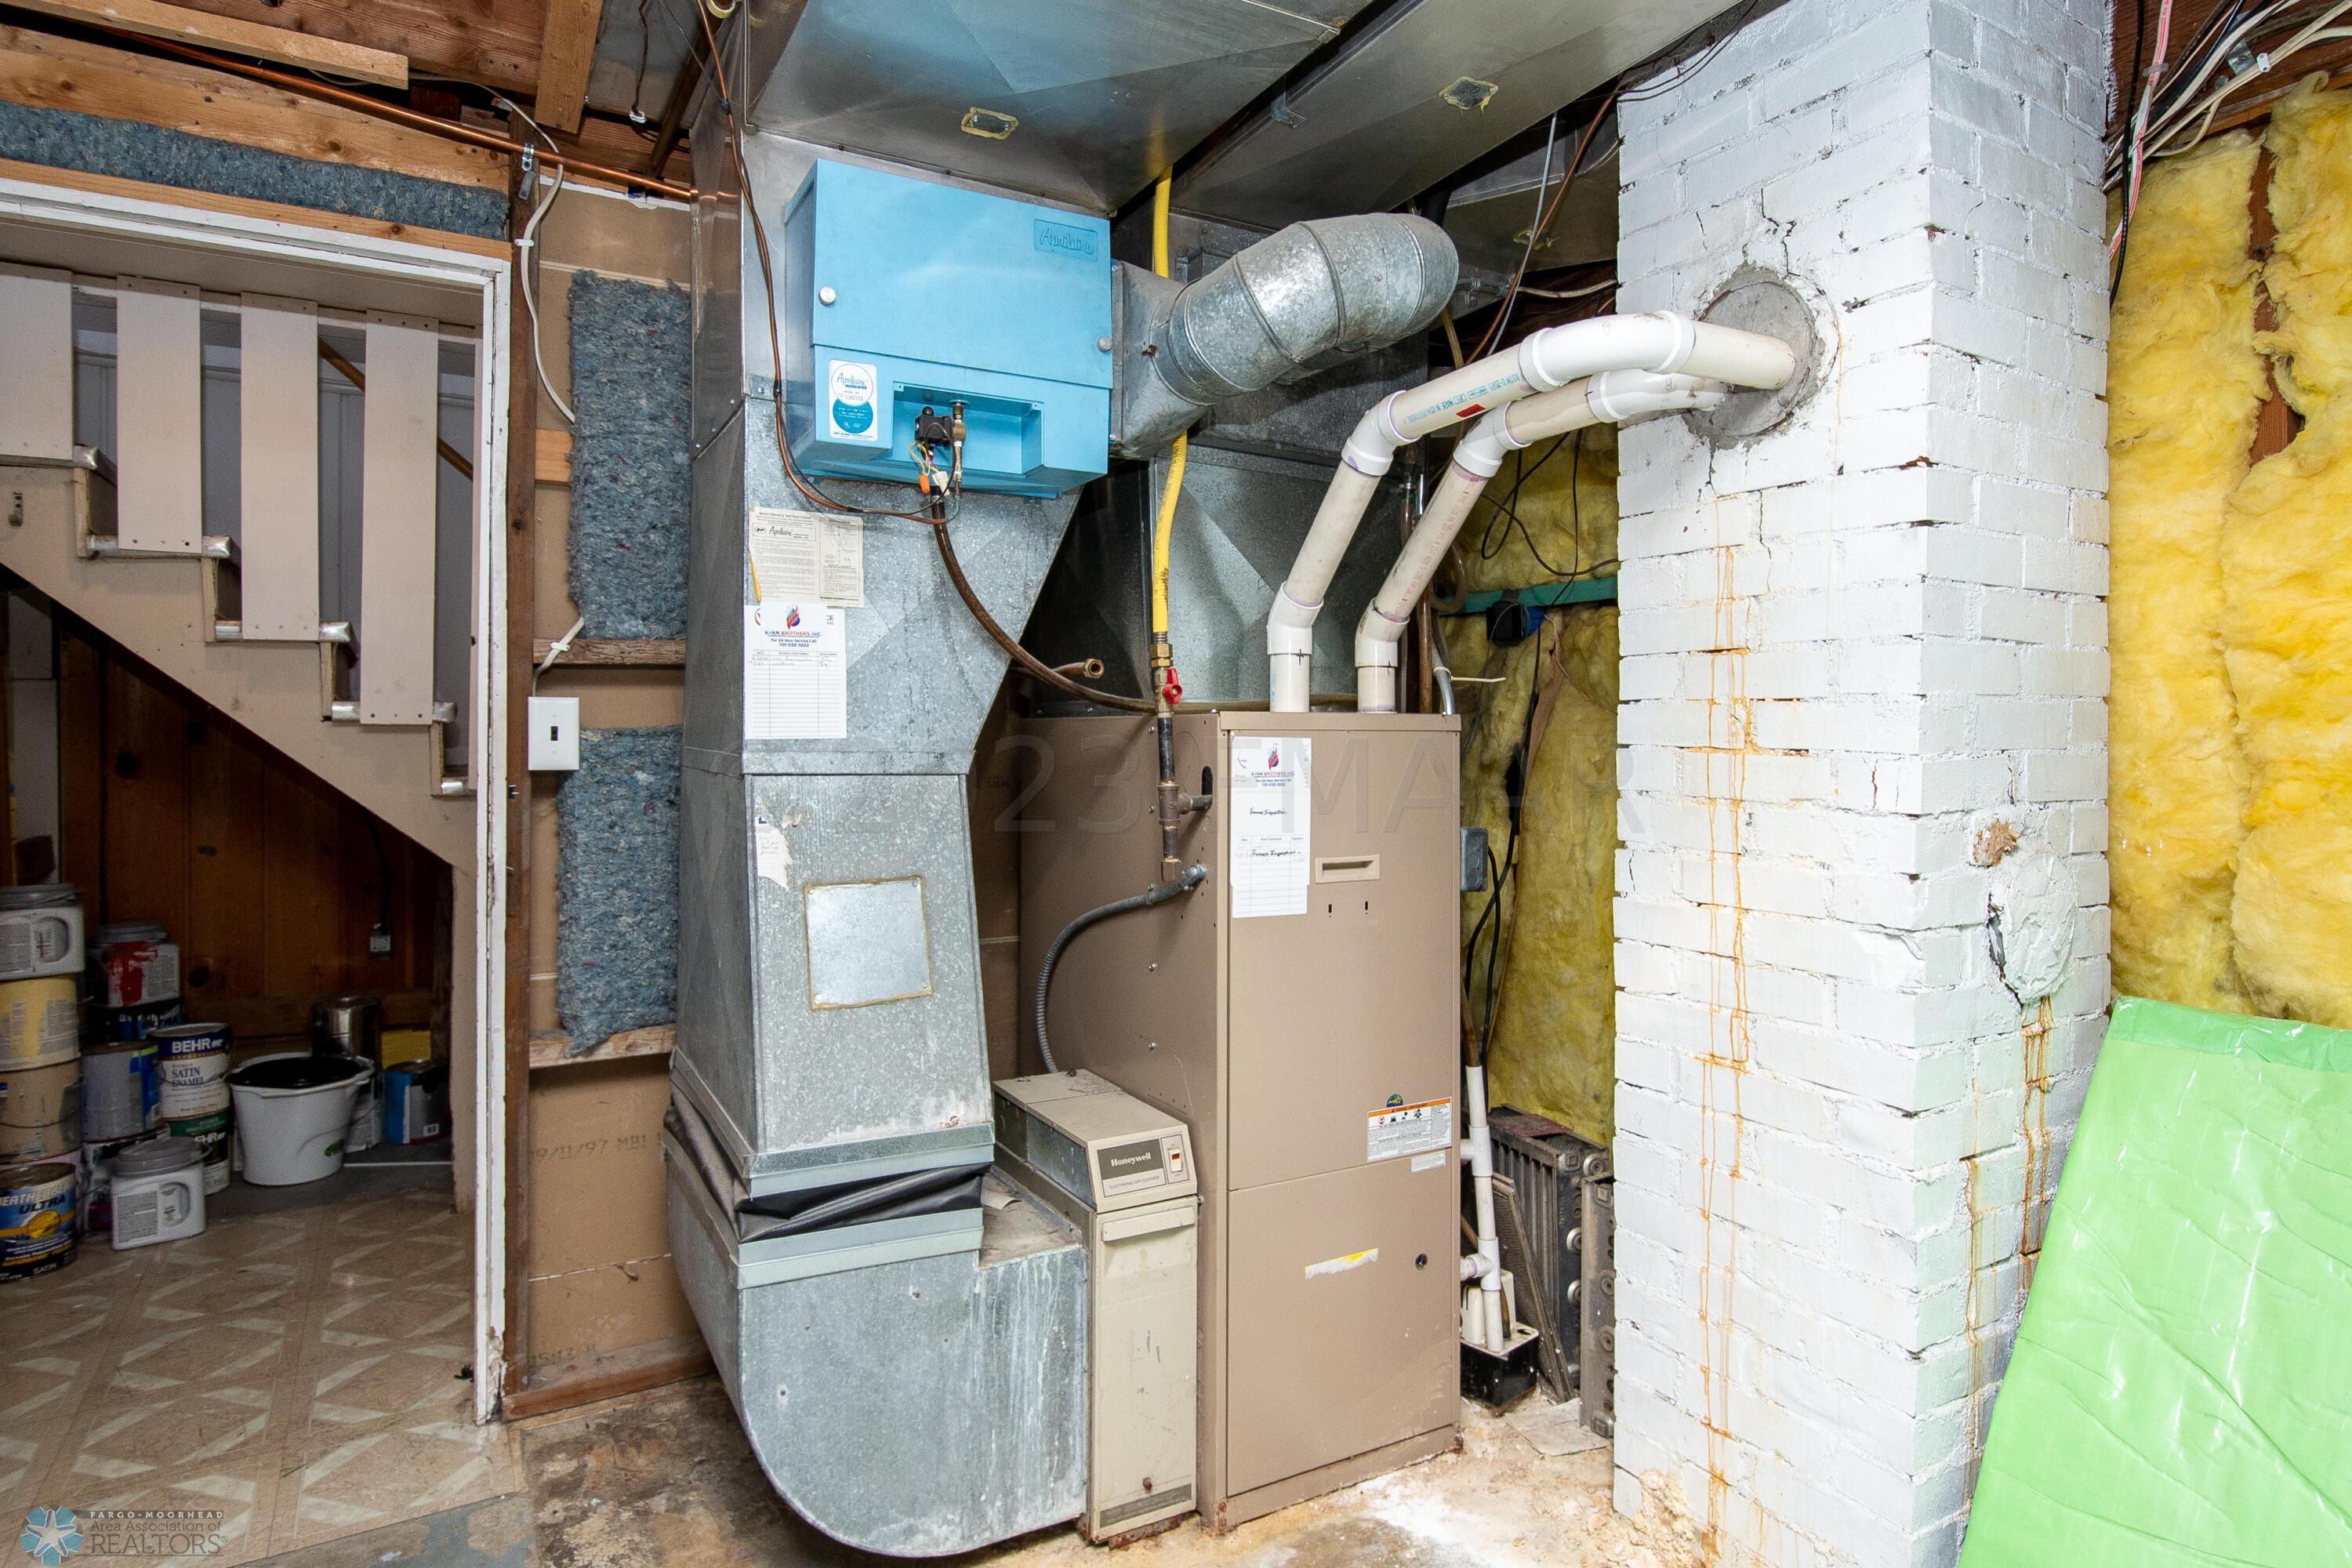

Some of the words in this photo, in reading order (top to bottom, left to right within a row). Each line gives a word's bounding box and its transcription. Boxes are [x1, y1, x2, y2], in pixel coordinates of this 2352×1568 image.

[172, 1037, 212, 1054] BEHR
[172, 1065, 201, 1079] SATIN
[1110, 1152, 1152, 1167] Honeywell
[19, 1194, 66, 1214] ULTRA
